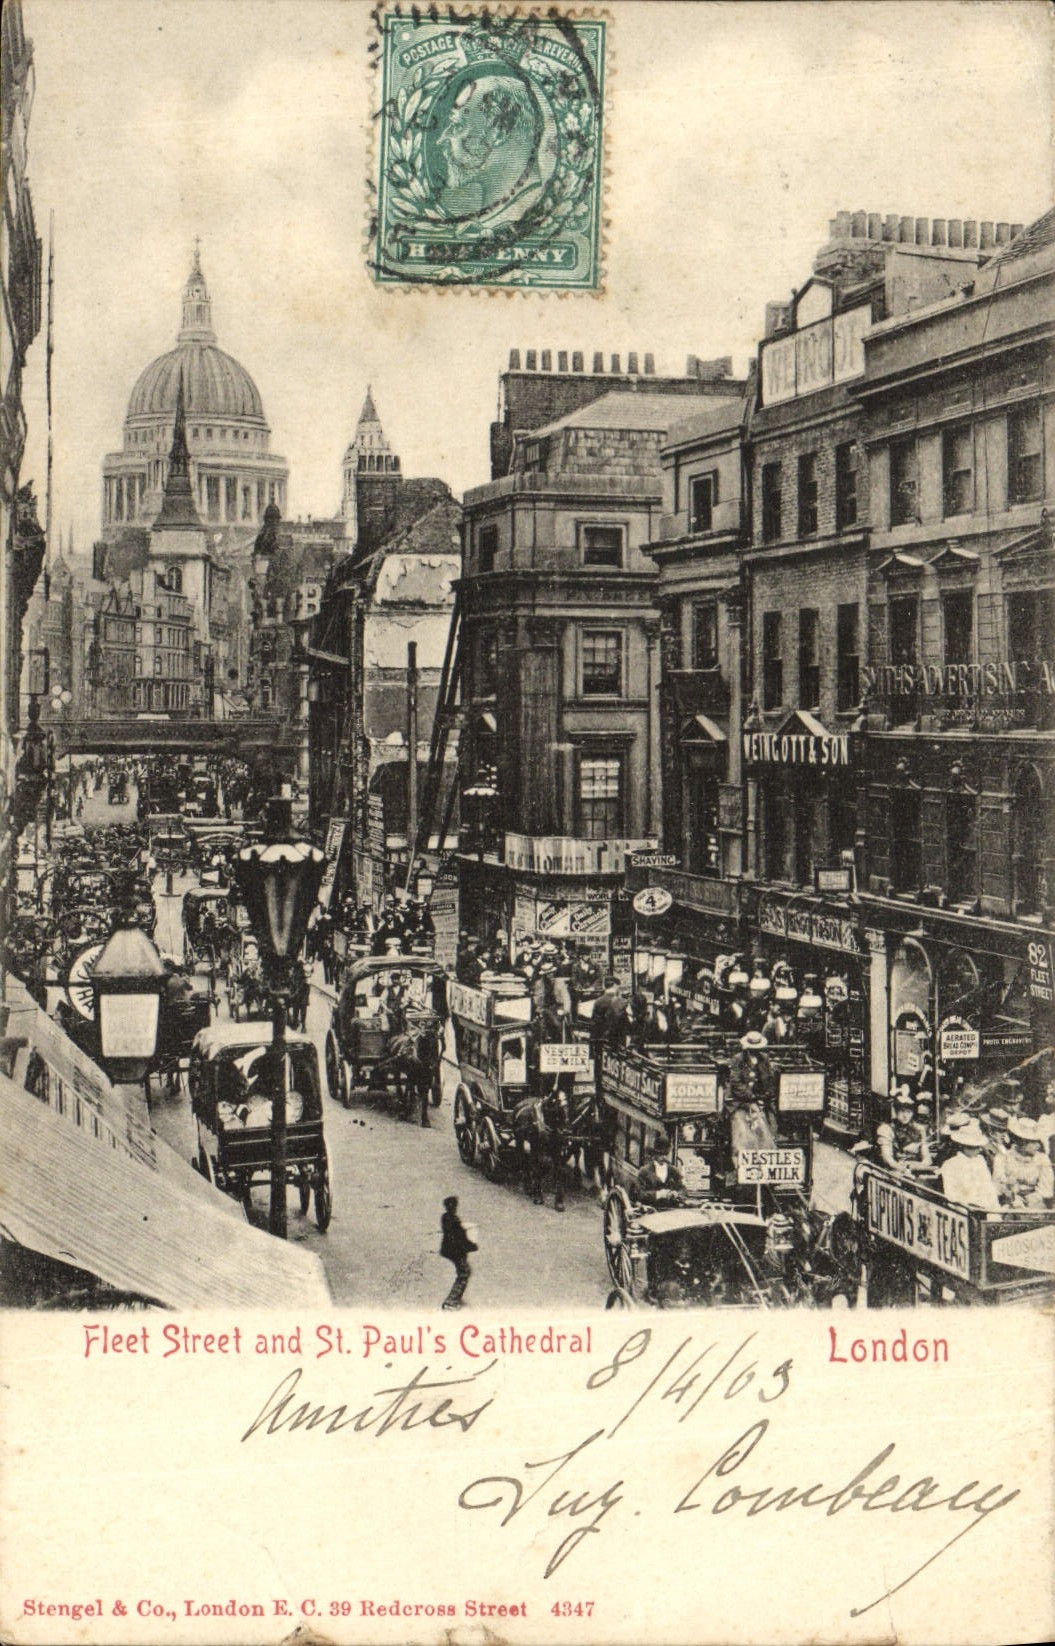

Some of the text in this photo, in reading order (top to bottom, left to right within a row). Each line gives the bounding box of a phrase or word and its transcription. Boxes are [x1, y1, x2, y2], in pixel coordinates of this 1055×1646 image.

[404, 36, 454, 65] POSTAGE
[808, 736, 817, 764] &
[821, 736, 848, 765] SON
[632, 855, 675, 866] SHAVING
[1027, 942, 1049, 968] 82
[1030, 968, 1049, 985] FLEET
[1030, 984, 1053, 1001] STREET
[560, 1057, 586, 1066] MILK
[640, 1071, 661, 1101] SALT
[669, 1085, 716, 1097] KODAK
[767, 1167, 800, 1181] MILK
[935, 1210, 967, 1273] TEAS
